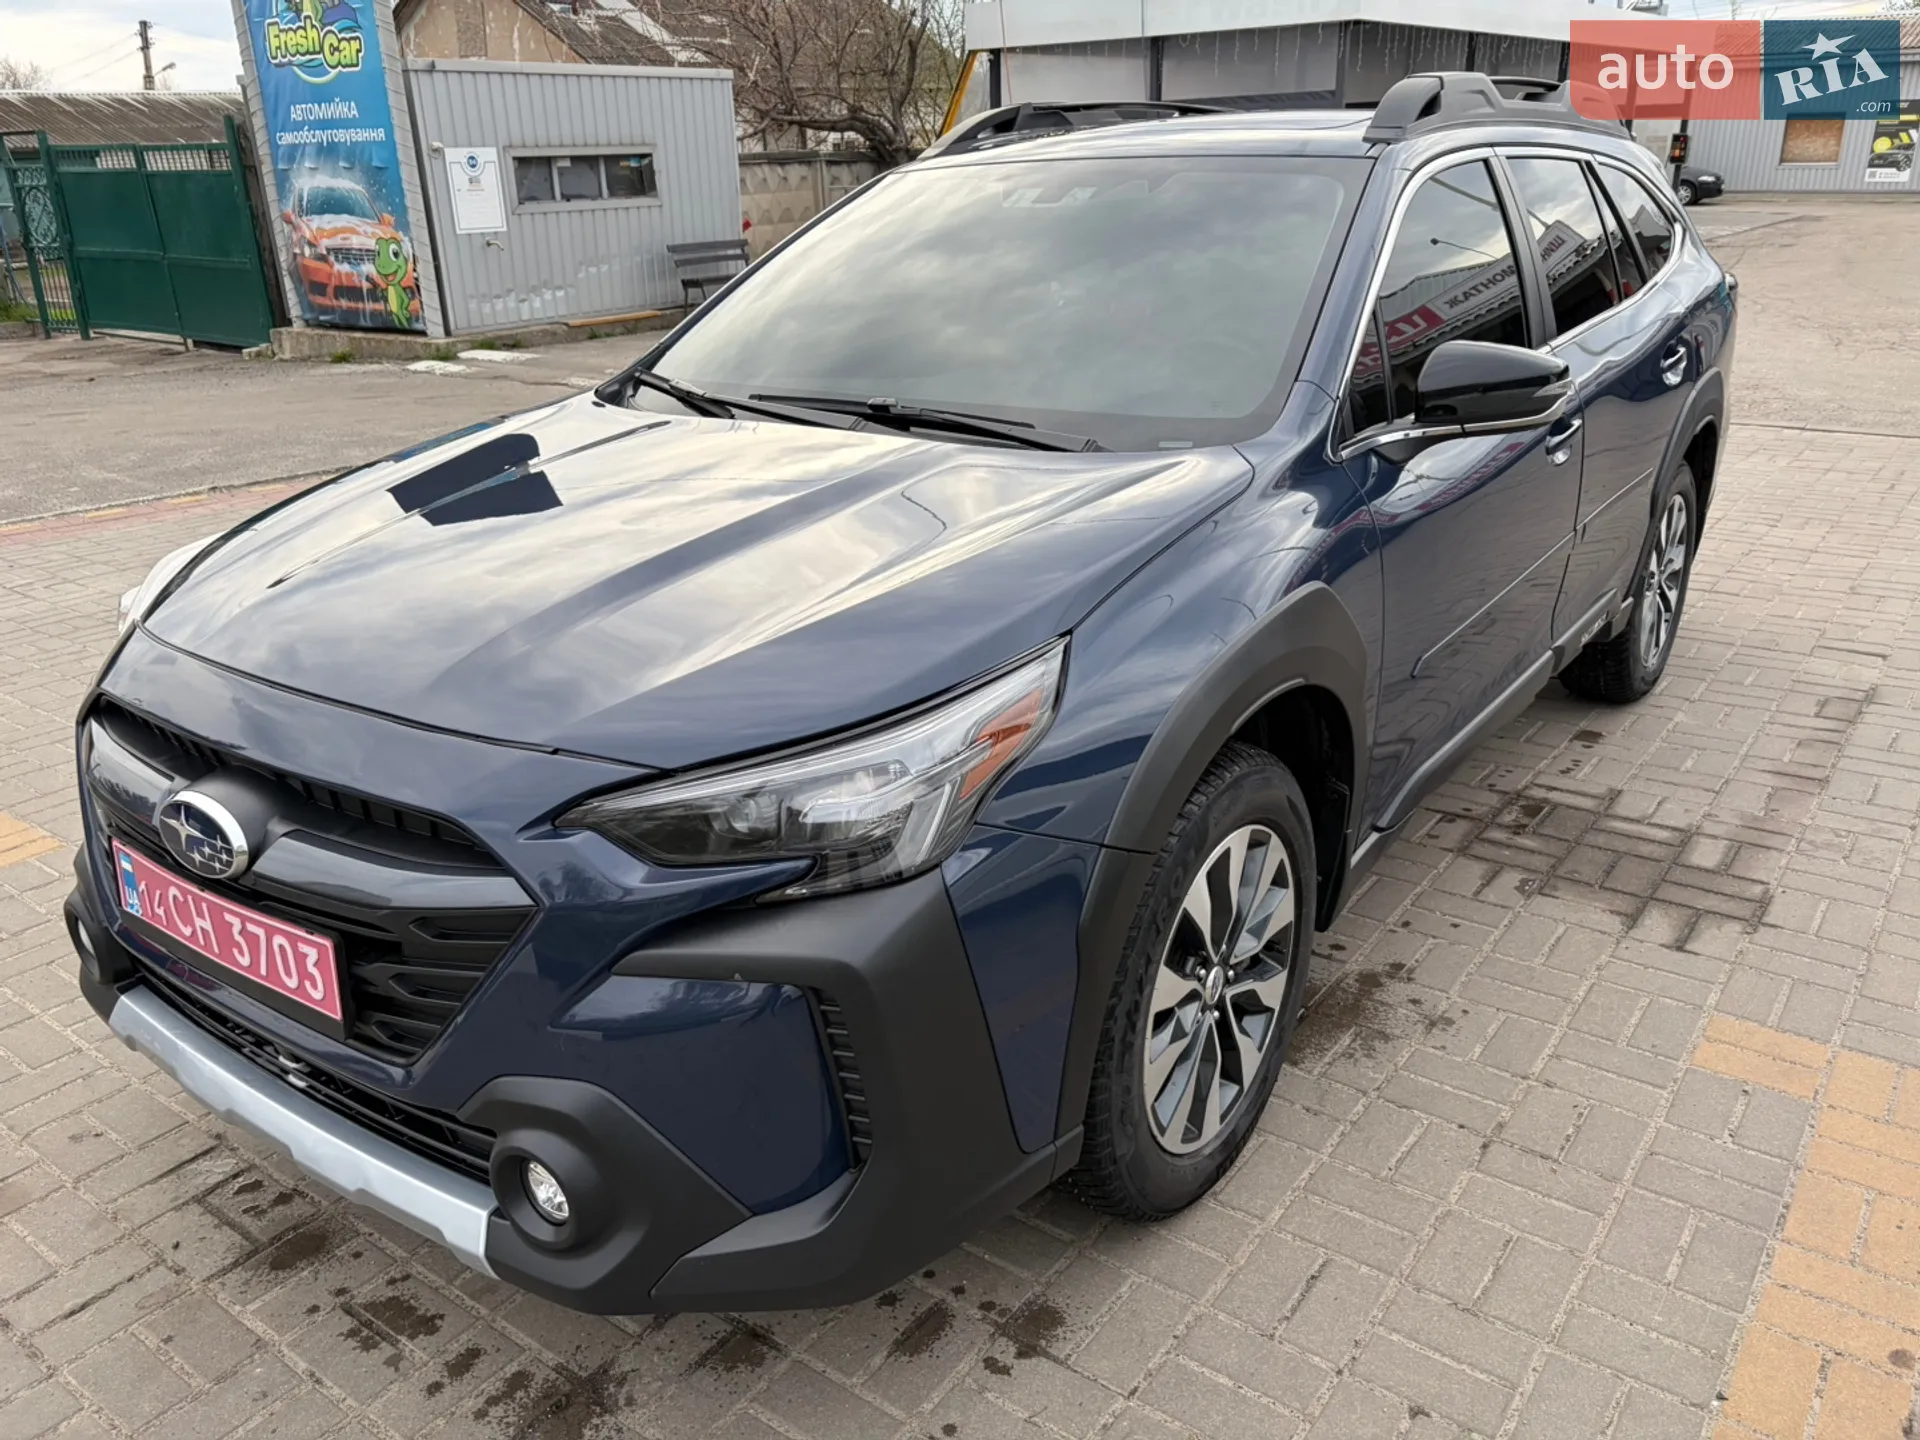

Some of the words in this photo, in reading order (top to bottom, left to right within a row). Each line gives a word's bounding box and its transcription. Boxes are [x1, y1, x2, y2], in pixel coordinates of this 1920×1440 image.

[266, 14, 321, 61] Fresh
[322, 28, 363, 70] Car
[290, 97, 359, 122] АВТОМИЙКА
[276, 126, 386, 147] самообслуговування
[223, 911, 325, 1001] 3703
